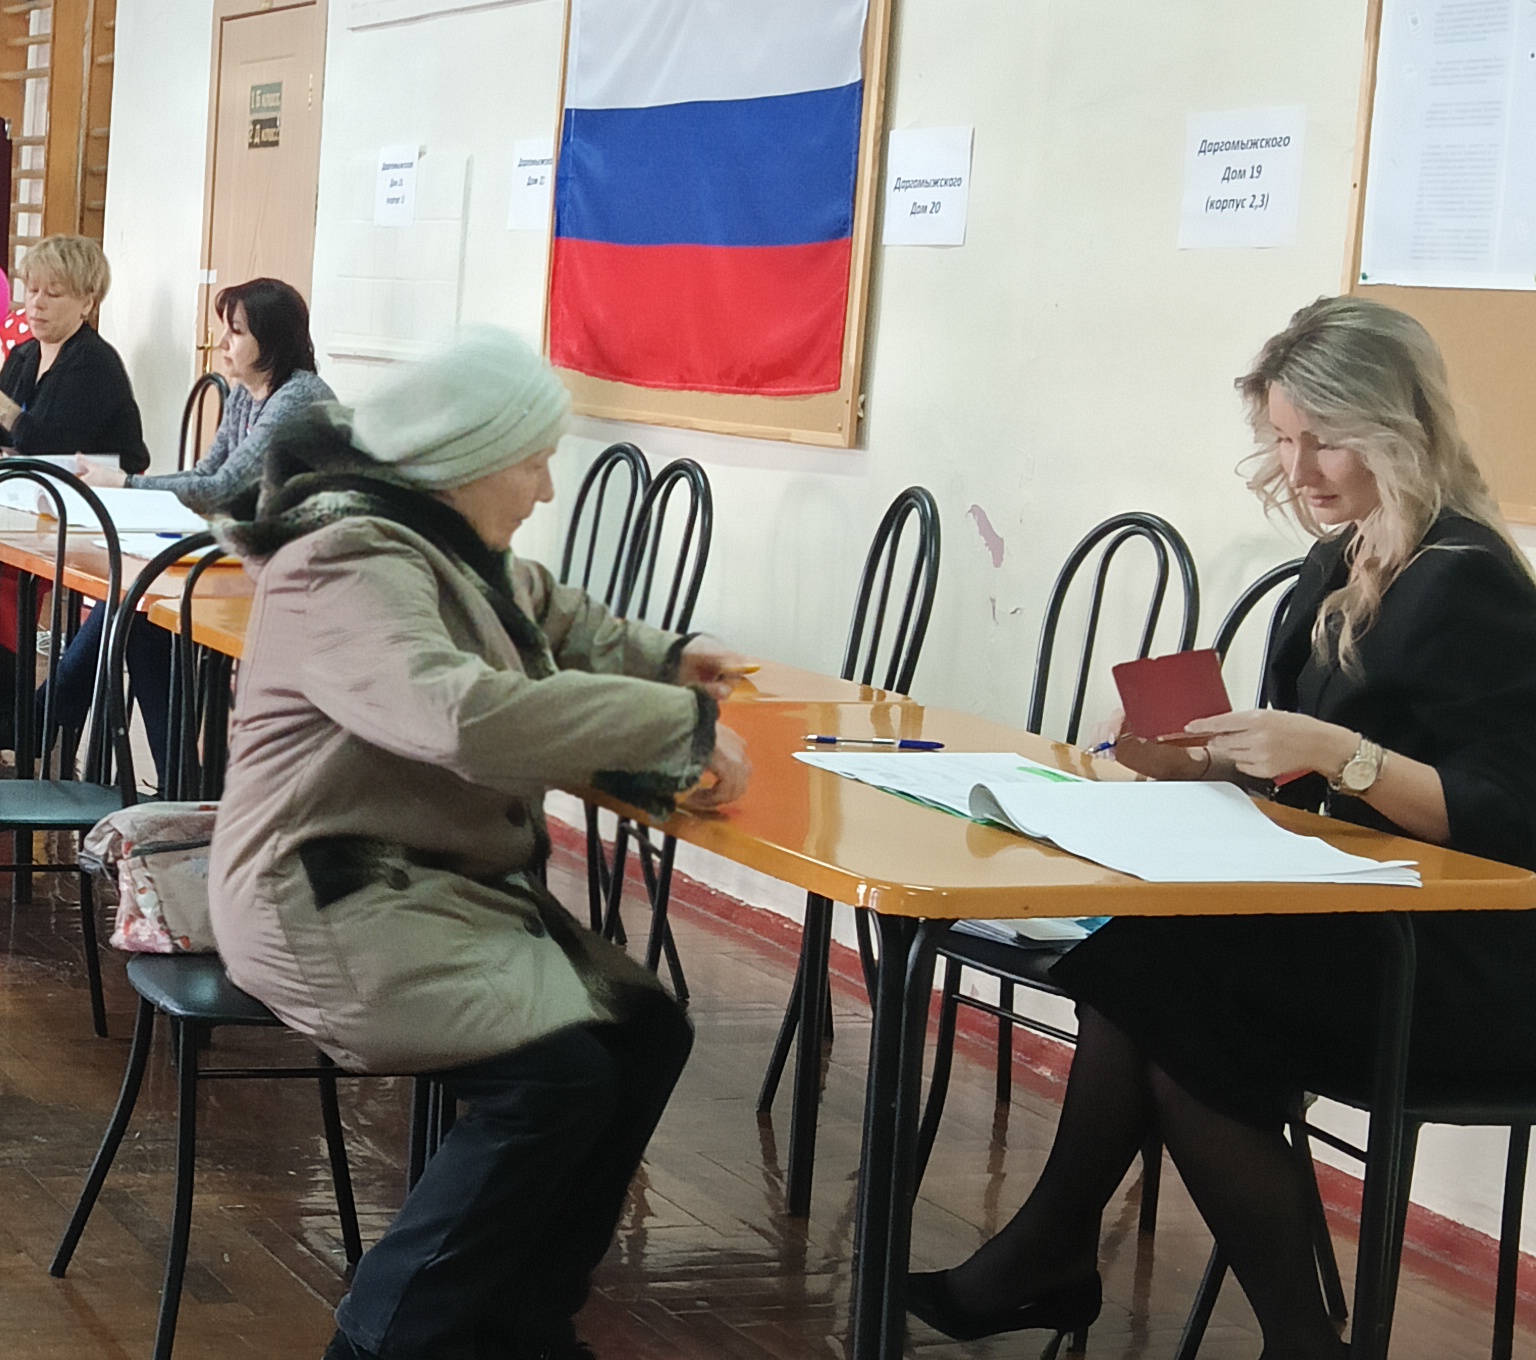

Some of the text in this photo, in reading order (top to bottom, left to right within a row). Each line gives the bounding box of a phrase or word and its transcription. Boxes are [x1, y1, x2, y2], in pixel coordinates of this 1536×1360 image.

[1197, 135, 1291, 157] Даргомыжского
[1221, 164, 1263, 184] Дом 19
[910, 201, 942, 217] Дом 20
[1205, 192, 1270, 213] (корпус 2,3)
